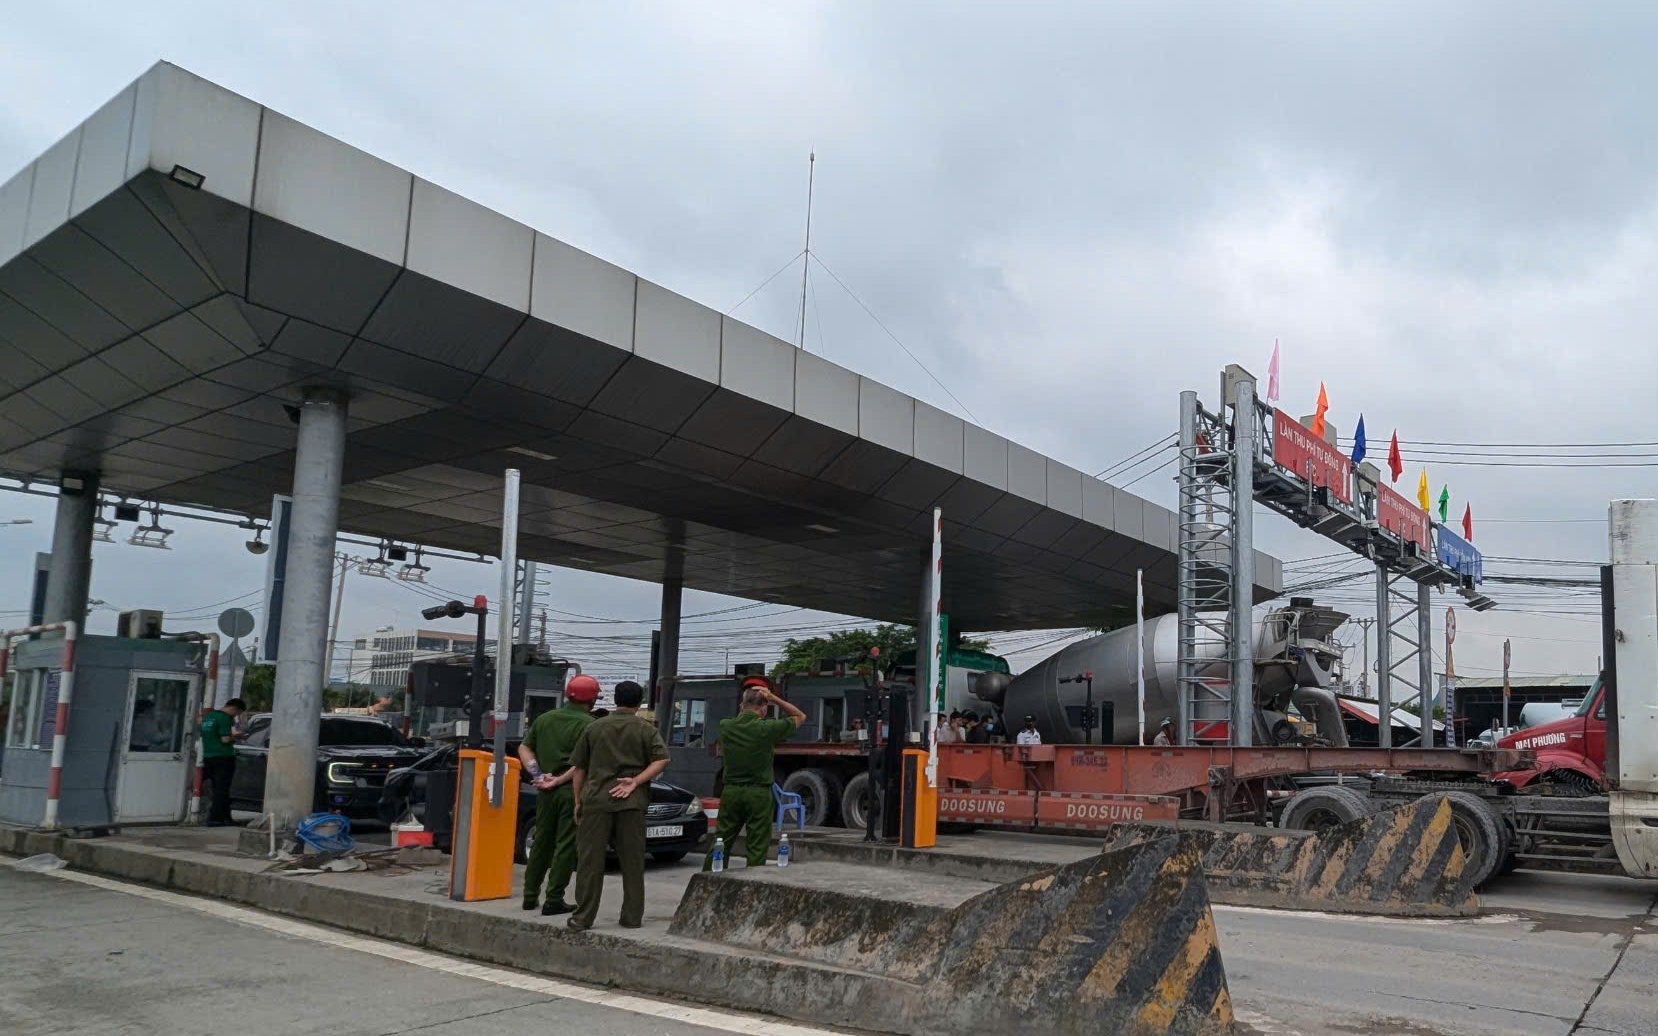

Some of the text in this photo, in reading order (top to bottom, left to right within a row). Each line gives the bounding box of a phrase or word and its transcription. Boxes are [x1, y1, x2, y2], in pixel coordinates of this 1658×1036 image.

[1280, 419, 1293, 441] LÀN
[1293, 431, 1306, 448] THU
[1306, 440, 1316, 455] PHÍ
[1306, 460, 1317, 477] EC
[941, 799, 1005, 813] DOOSUNG
[1067, 804, 1143, 820] DOOSUNG
